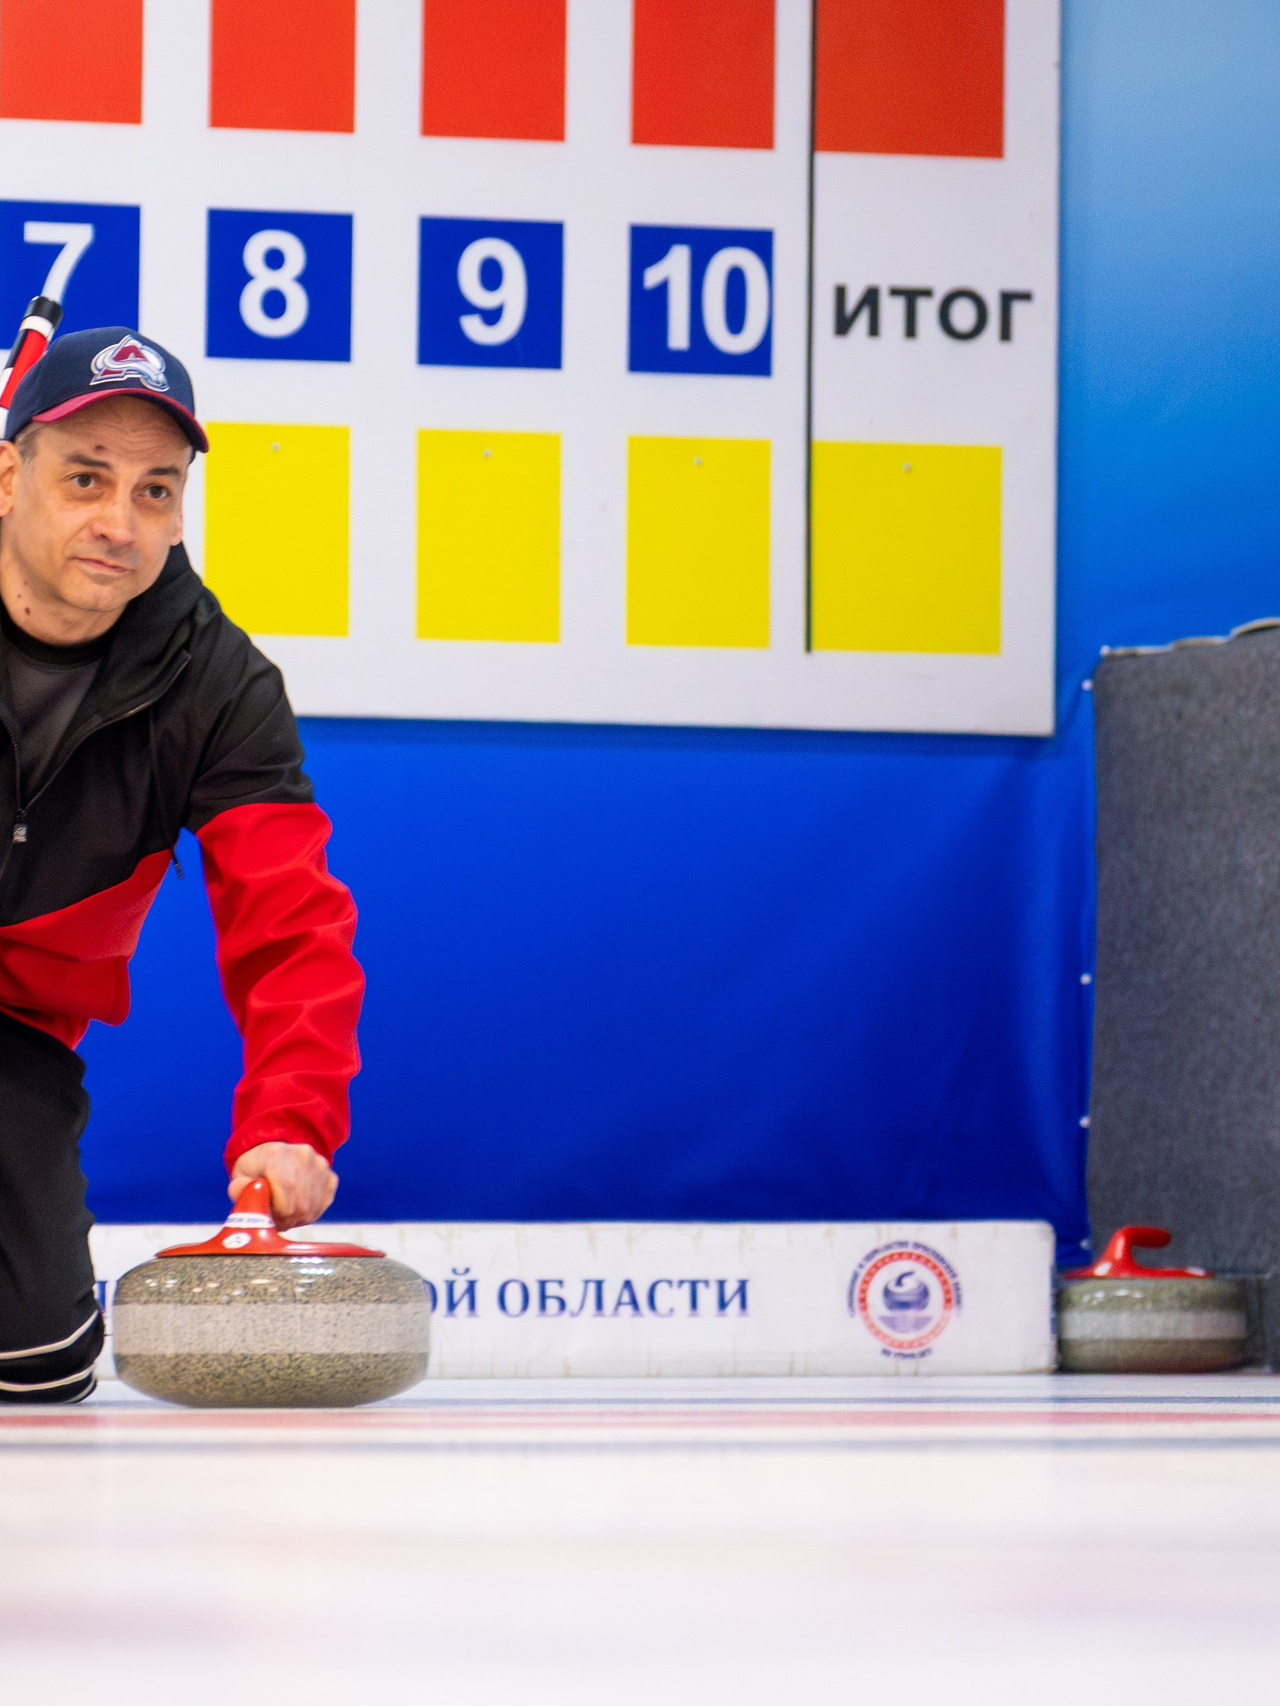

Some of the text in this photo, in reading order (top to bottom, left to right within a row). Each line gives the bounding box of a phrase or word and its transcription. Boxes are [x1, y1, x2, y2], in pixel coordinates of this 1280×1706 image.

[23, 221, 95, 301] 7
[239, 229, 309, 338] 8
[457, 237, 527, 345] 9
[643, 244, 770, 354] 10
[832, 284, 1034, 343] ИТОГ
[495, 1278, 750, 1319] ОБЛАСТИ
